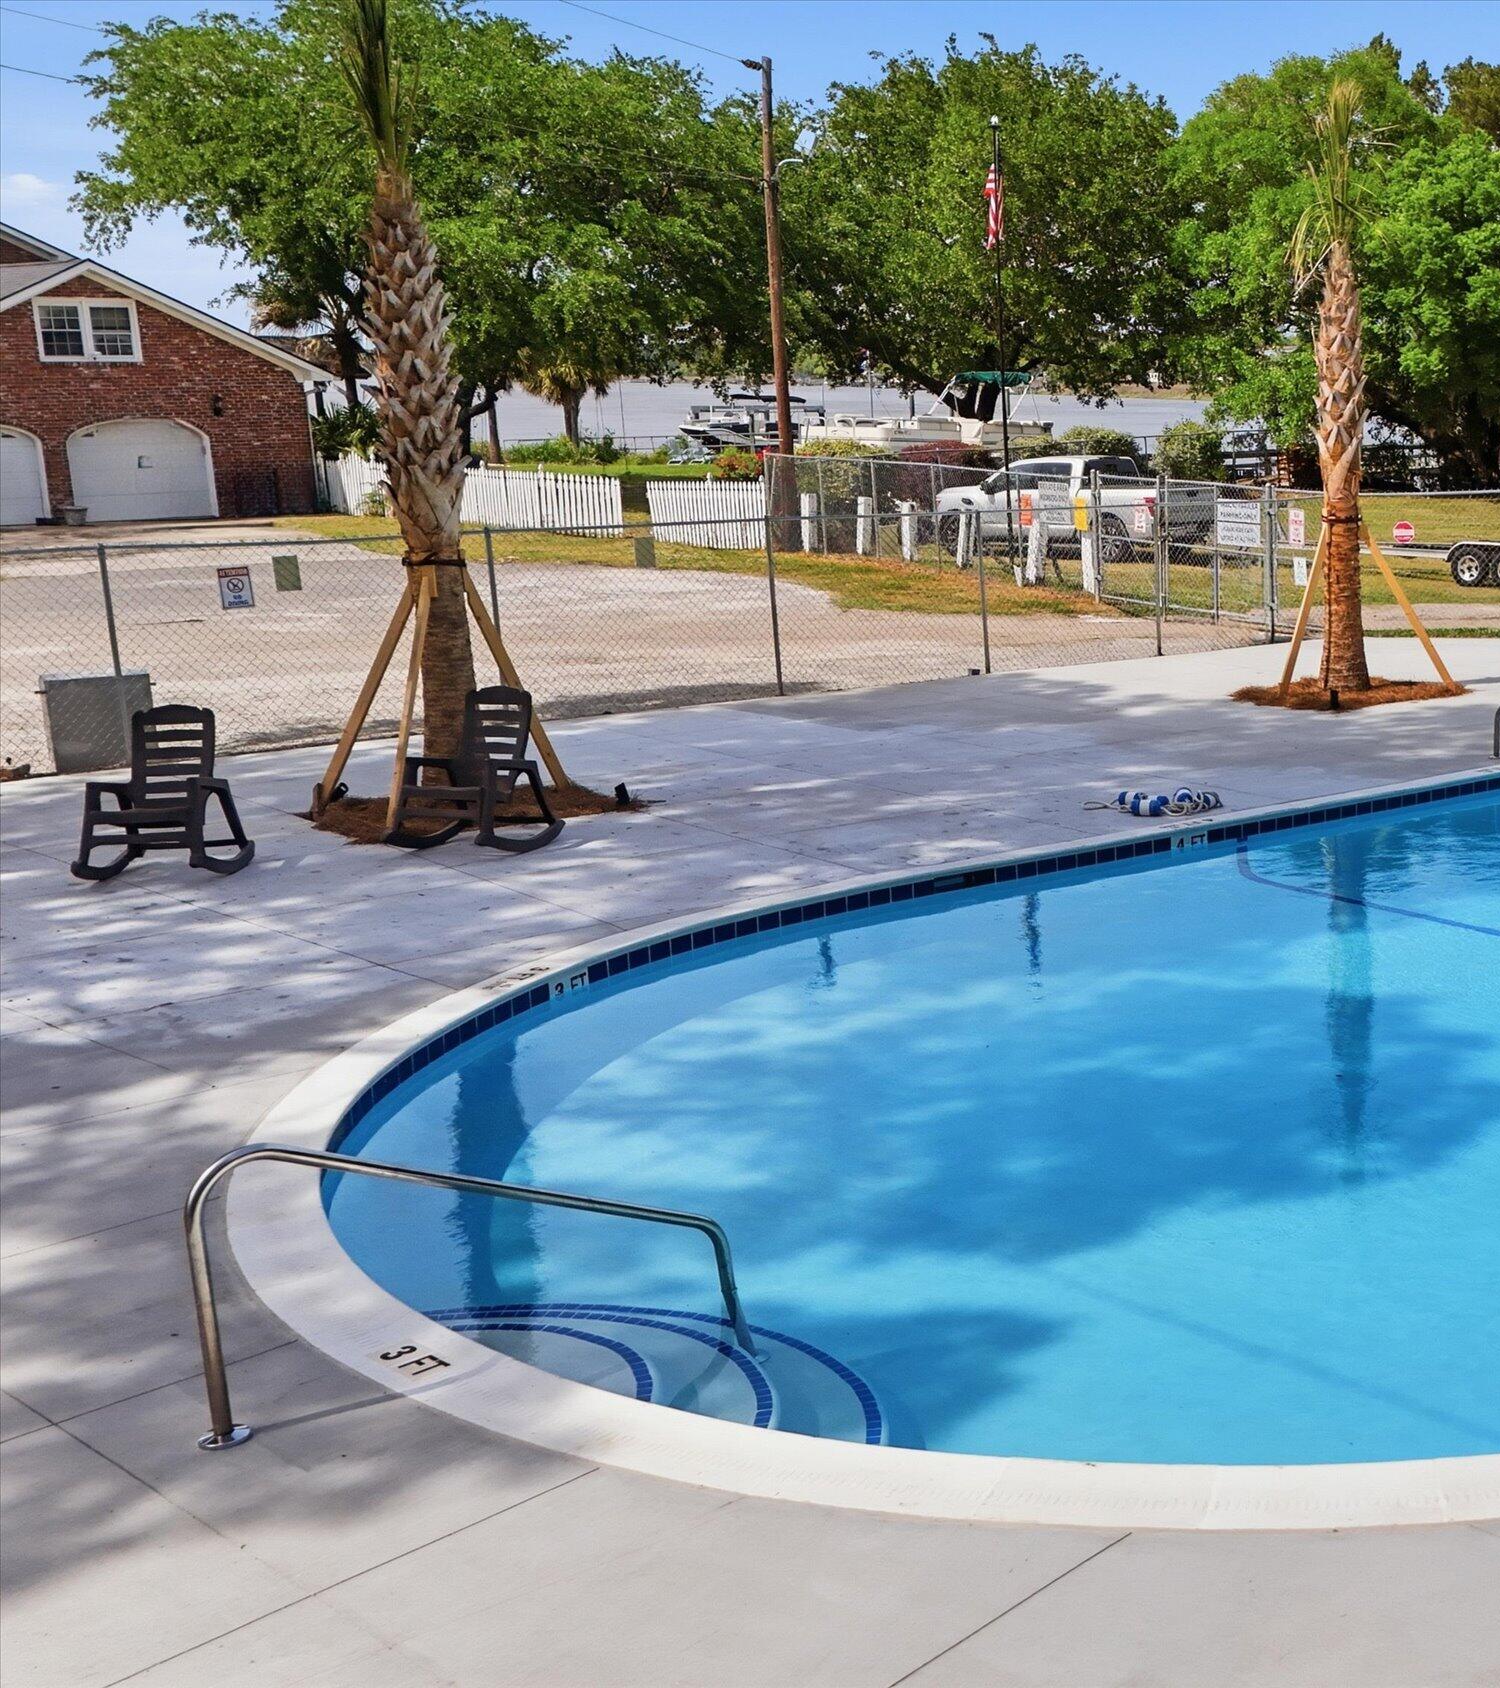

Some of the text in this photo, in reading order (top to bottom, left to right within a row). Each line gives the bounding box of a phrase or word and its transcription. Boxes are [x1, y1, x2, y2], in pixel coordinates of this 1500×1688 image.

[570, 972, 587, 989] FT
[380, 1345, 451, 1376] 3 FT
